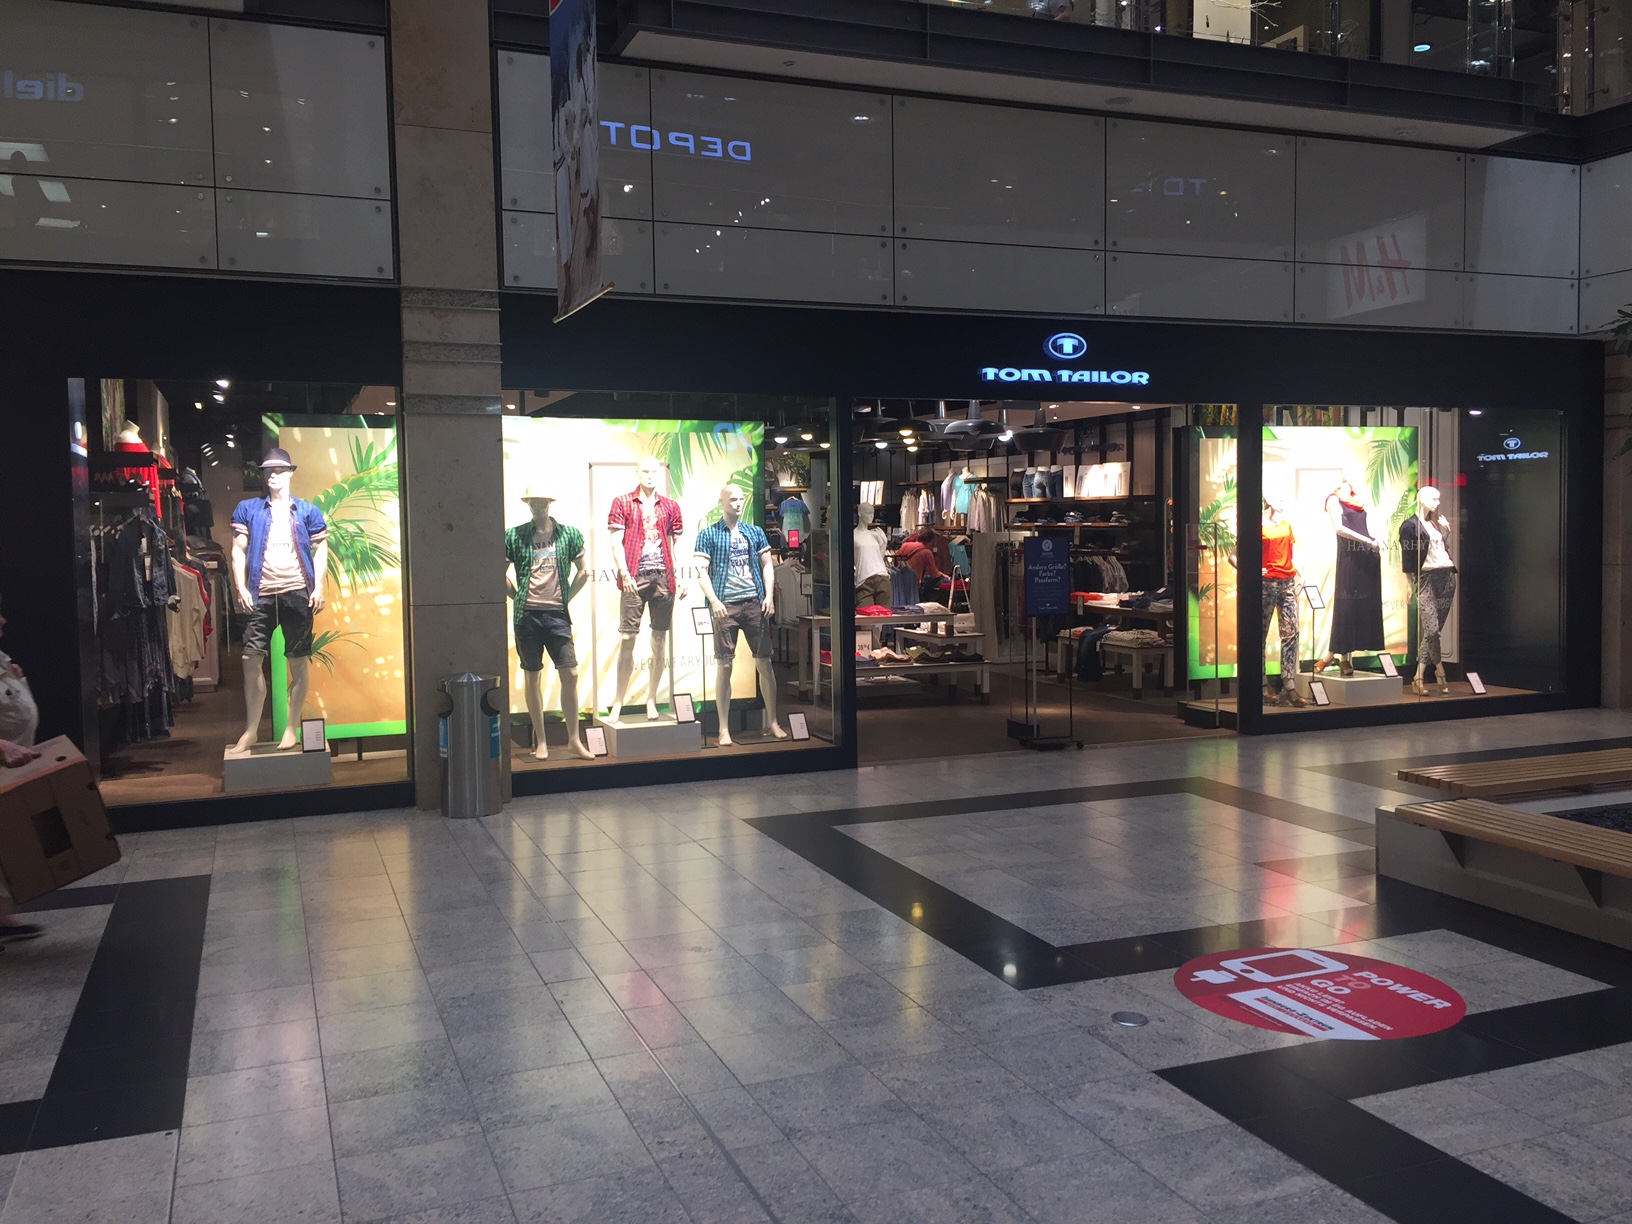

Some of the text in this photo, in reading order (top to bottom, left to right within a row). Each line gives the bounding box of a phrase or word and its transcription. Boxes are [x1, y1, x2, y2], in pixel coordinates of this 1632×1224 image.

[980, 367, 1150, 385] TOM TAILOR
[1477, 451, 1549, 462] TOM TAILOR
[1310, 979, 1351, 994] GO
[1334, 975, 1371, 989] TO
[1352, 971, 1452, 1010] POWER
[1277, 985, 1296, 994] UND
[1295, 993, 1327, 1007] NICHTS
[1286, 984, 1321, 999] EINFACH
[1345, 1010, 1393, 1030] AUFLADEN
